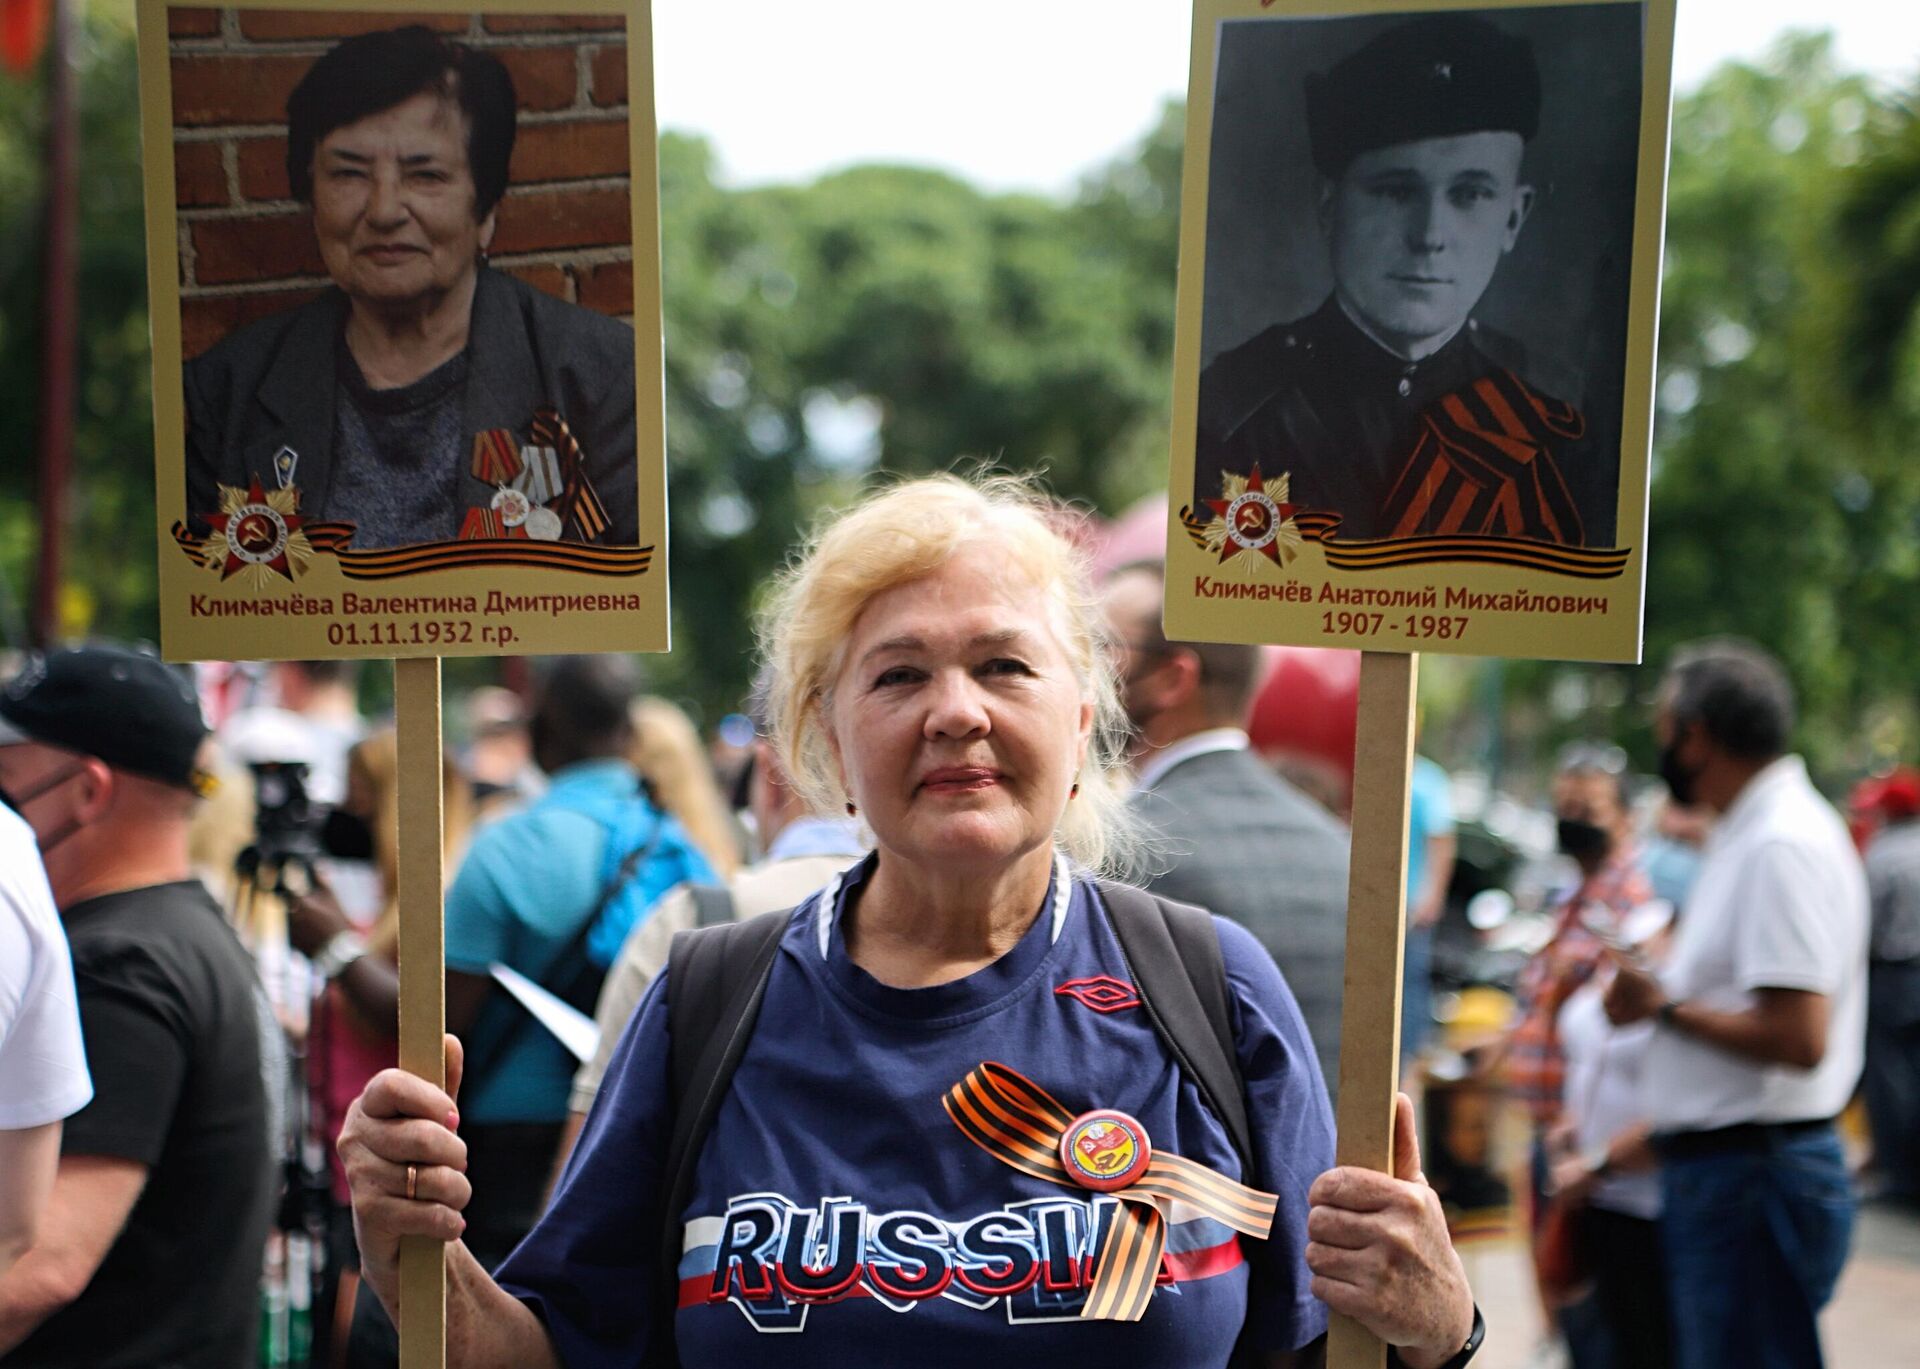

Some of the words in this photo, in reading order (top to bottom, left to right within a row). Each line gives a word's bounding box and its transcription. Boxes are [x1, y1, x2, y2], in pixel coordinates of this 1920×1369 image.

[190, 594, 334, 617] Климачёва
[342, 592, 477, 615] Валентина
[483, 591, 641, 617] Дмитриевна
[1195, 576, 1312, 602] Климачёв
[1318, 581, 1436, 608] Анатолий
[1445, 587, 1608, 614] Михайлович
[327, 621, 473, 646] 01.11.1932
[481, 625, 519, 647] г.р.
[1322, 611, 1384, 636] 1907
[1405, 615, 1469, 639] 1987
